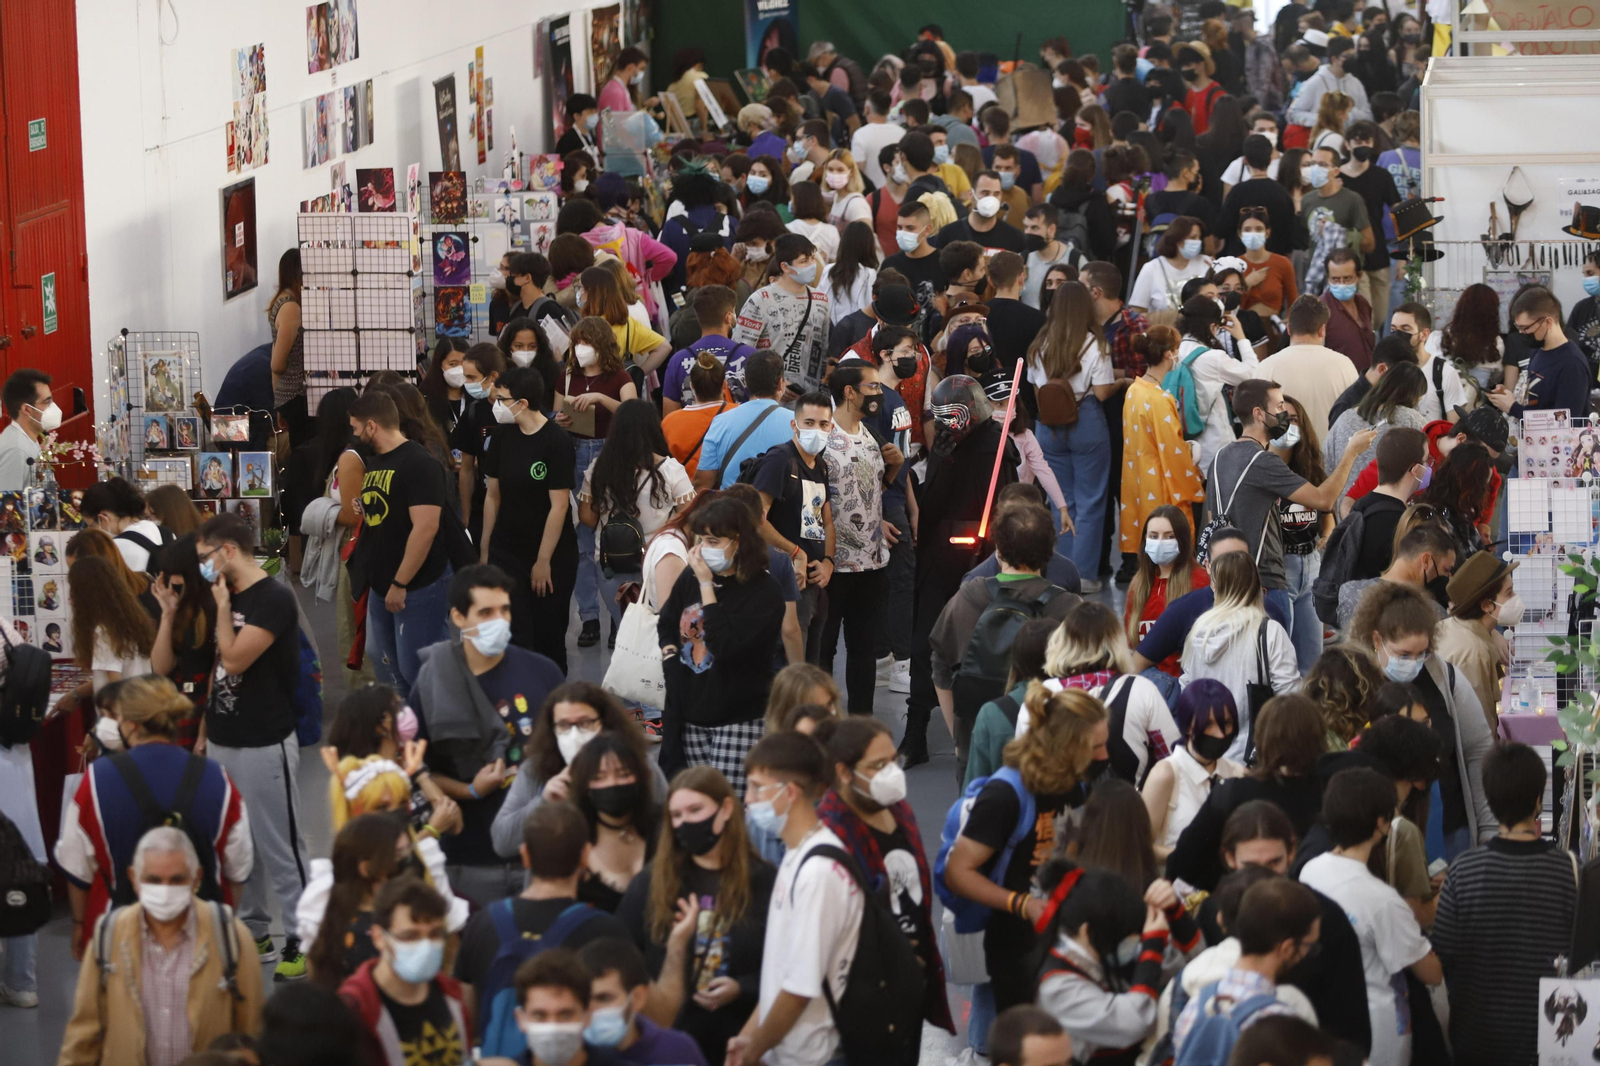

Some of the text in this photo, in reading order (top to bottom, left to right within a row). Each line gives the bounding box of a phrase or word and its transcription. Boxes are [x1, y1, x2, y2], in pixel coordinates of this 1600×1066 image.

[743, 318, 762, 330] York
[361, 469, 395, 496] ATMAN
[1294, 511, 1317, 523] WORLD
